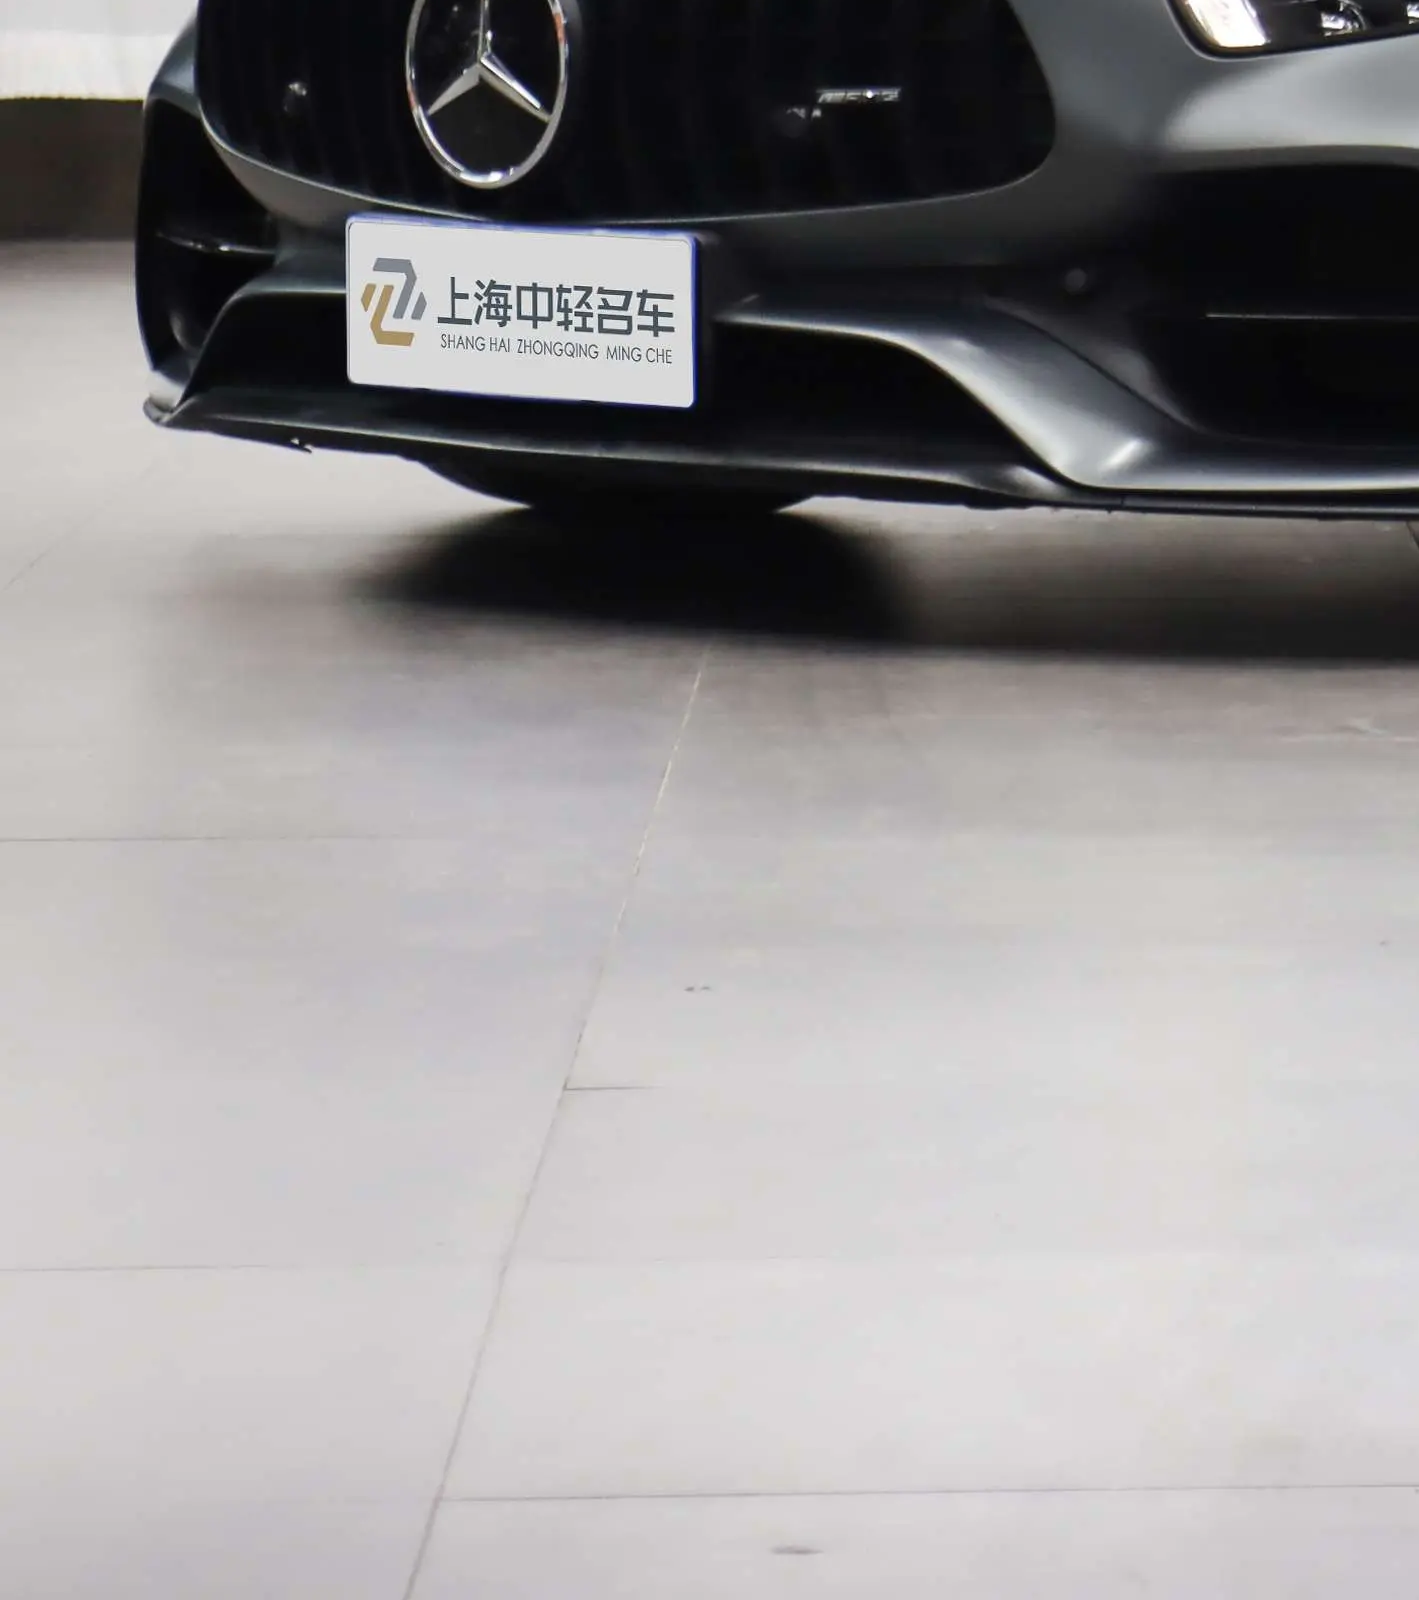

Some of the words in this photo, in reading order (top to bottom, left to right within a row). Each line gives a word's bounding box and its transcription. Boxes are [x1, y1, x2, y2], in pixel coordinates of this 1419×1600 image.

[437, 276, 675, 338] 上海中轻名车
[440, 333, 486, 352] SHANG
[489, 336, 511, 353] HAI
[516, 338, 600, 360] ZHONGQING
[606, 345, 643, 363] MING
[645, 347, 673, 365] CHE
